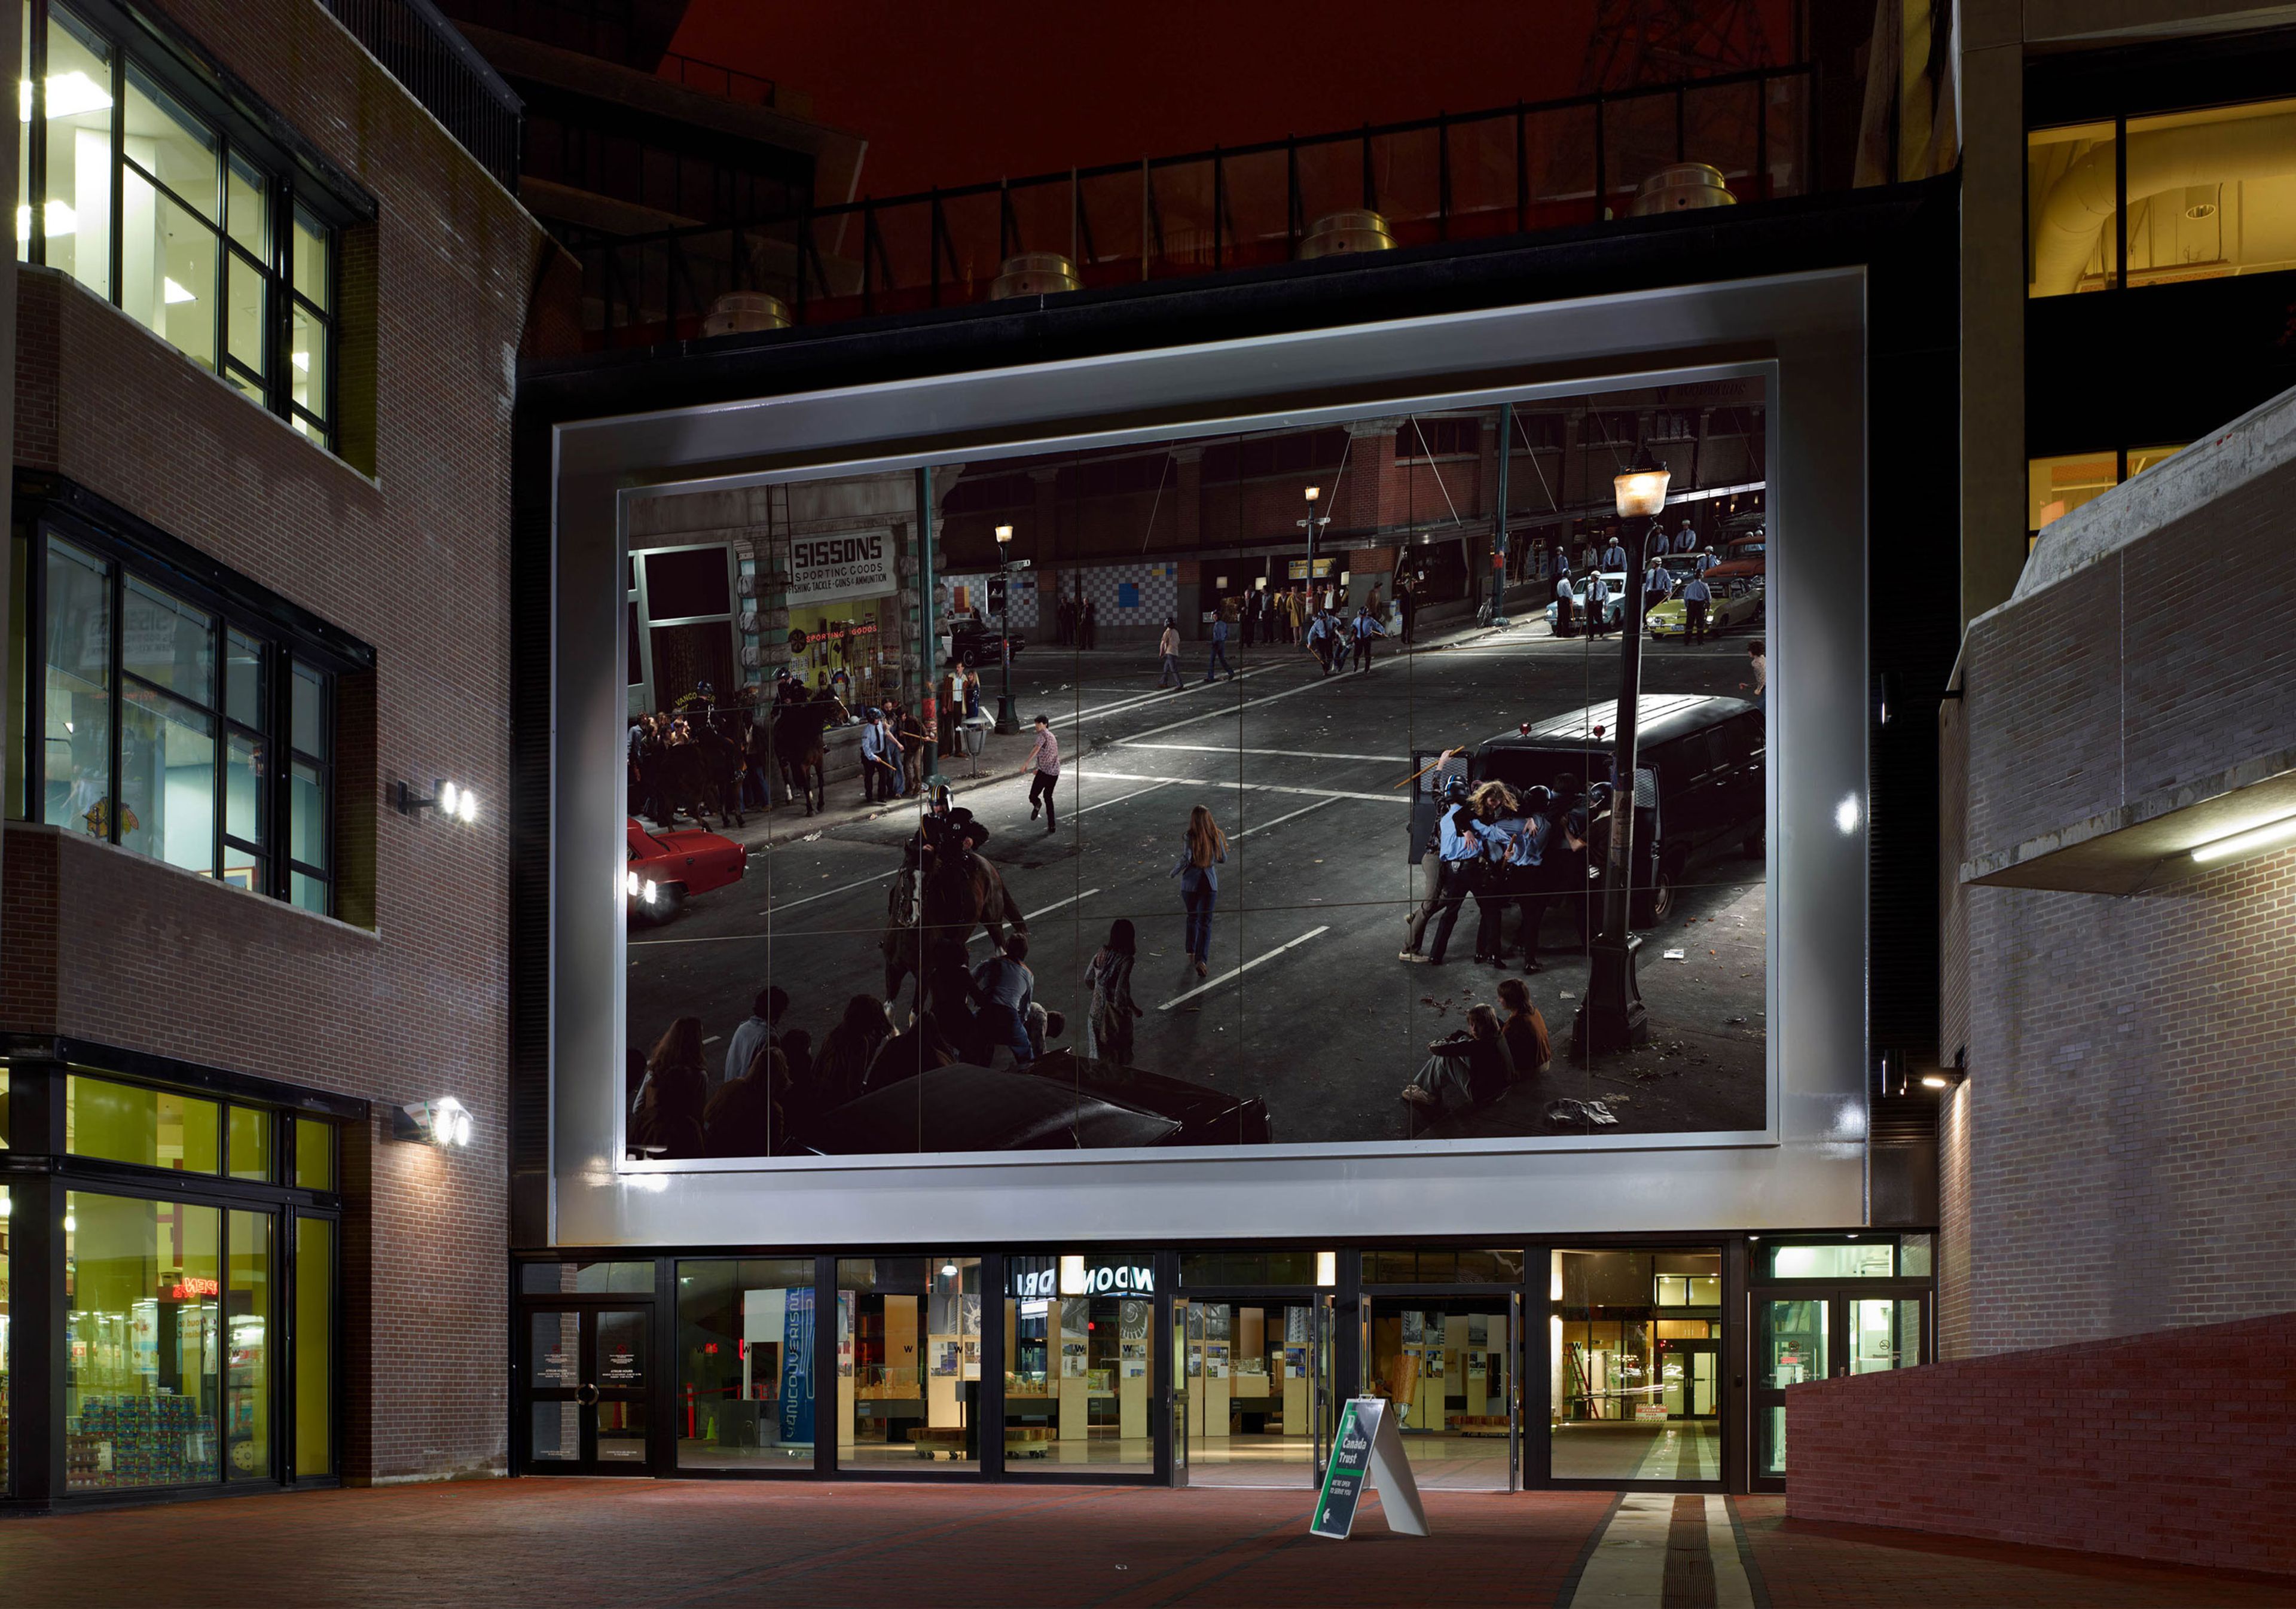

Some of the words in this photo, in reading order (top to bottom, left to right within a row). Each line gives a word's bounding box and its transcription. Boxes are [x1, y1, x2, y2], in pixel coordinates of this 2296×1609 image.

[795, 536, 882, 568] SISSONS
[795, 567, 847, 582] SPORTING
[850, 563, 883, 575] GOODS
[787, 582, 811, 594] FISHING
[812, 579, 832, 591] TACKLE
[835, 577, 851, 588] GUNS
[855, 573, 887, 585] AMMUNITION
[806, 630, 844, 643] SPORTING
[851, 625, 877, 635] GOODS
[674, 692, 716, 706] VANCOER
[786, 1287, 800, 1438] VANCOUVERISM
[1346, 1415, 1355, 1429] TD
[1342, 1437, 1367, 1450] Canada
[1339, 1452, 1358, 1464] Trust
